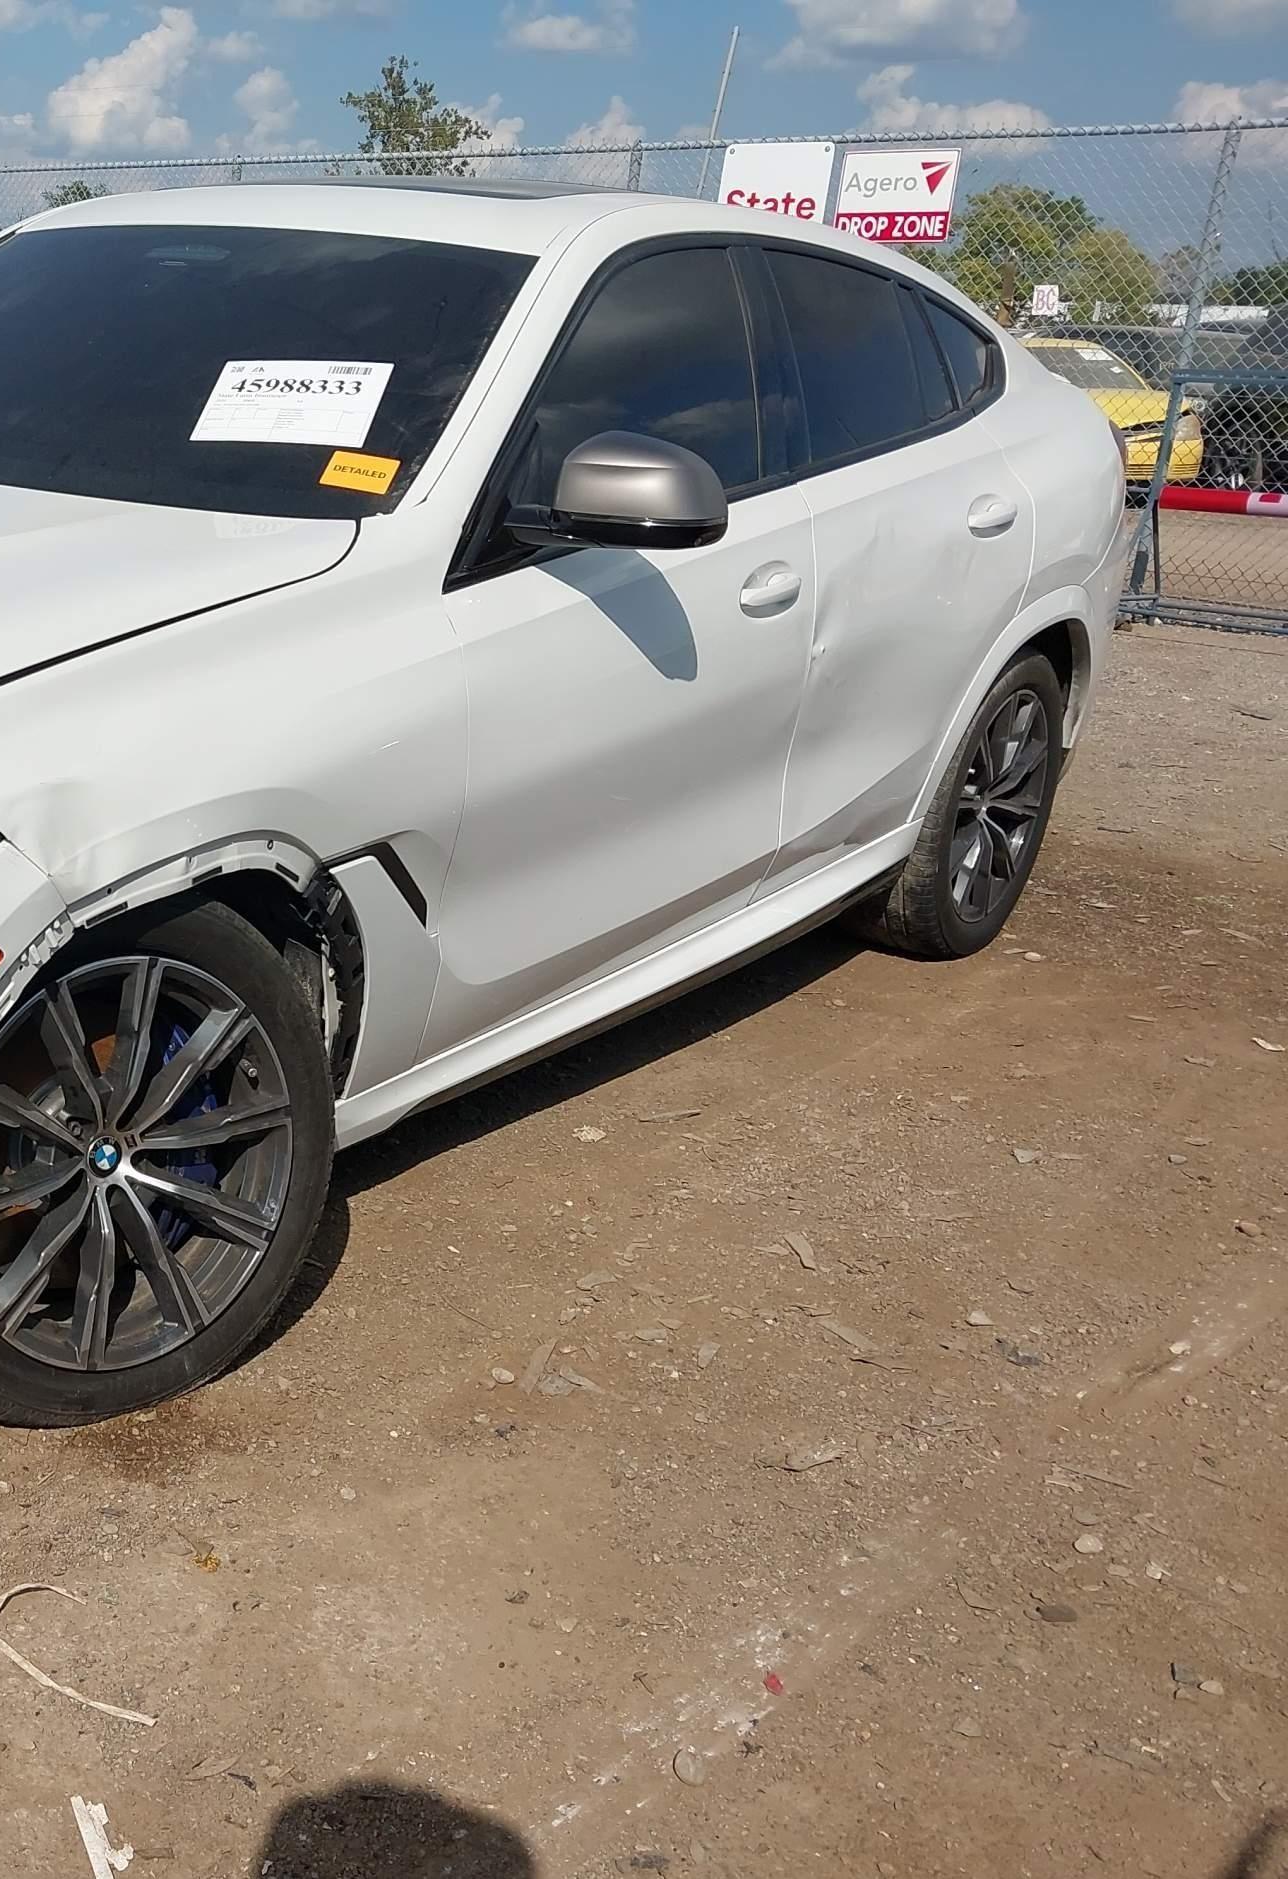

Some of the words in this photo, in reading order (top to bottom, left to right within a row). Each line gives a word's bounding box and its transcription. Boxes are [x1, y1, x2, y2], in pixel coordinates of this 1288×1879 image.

[845, 172, 918, 197] Agero
[727, 190, 816, 220] State
[838, 216, 888, 237] DROP
[892, 216, 945, 237] ZONE
[231, 378, 362, 395] 45988333
[333, 464, 387, 480] DETAILED
